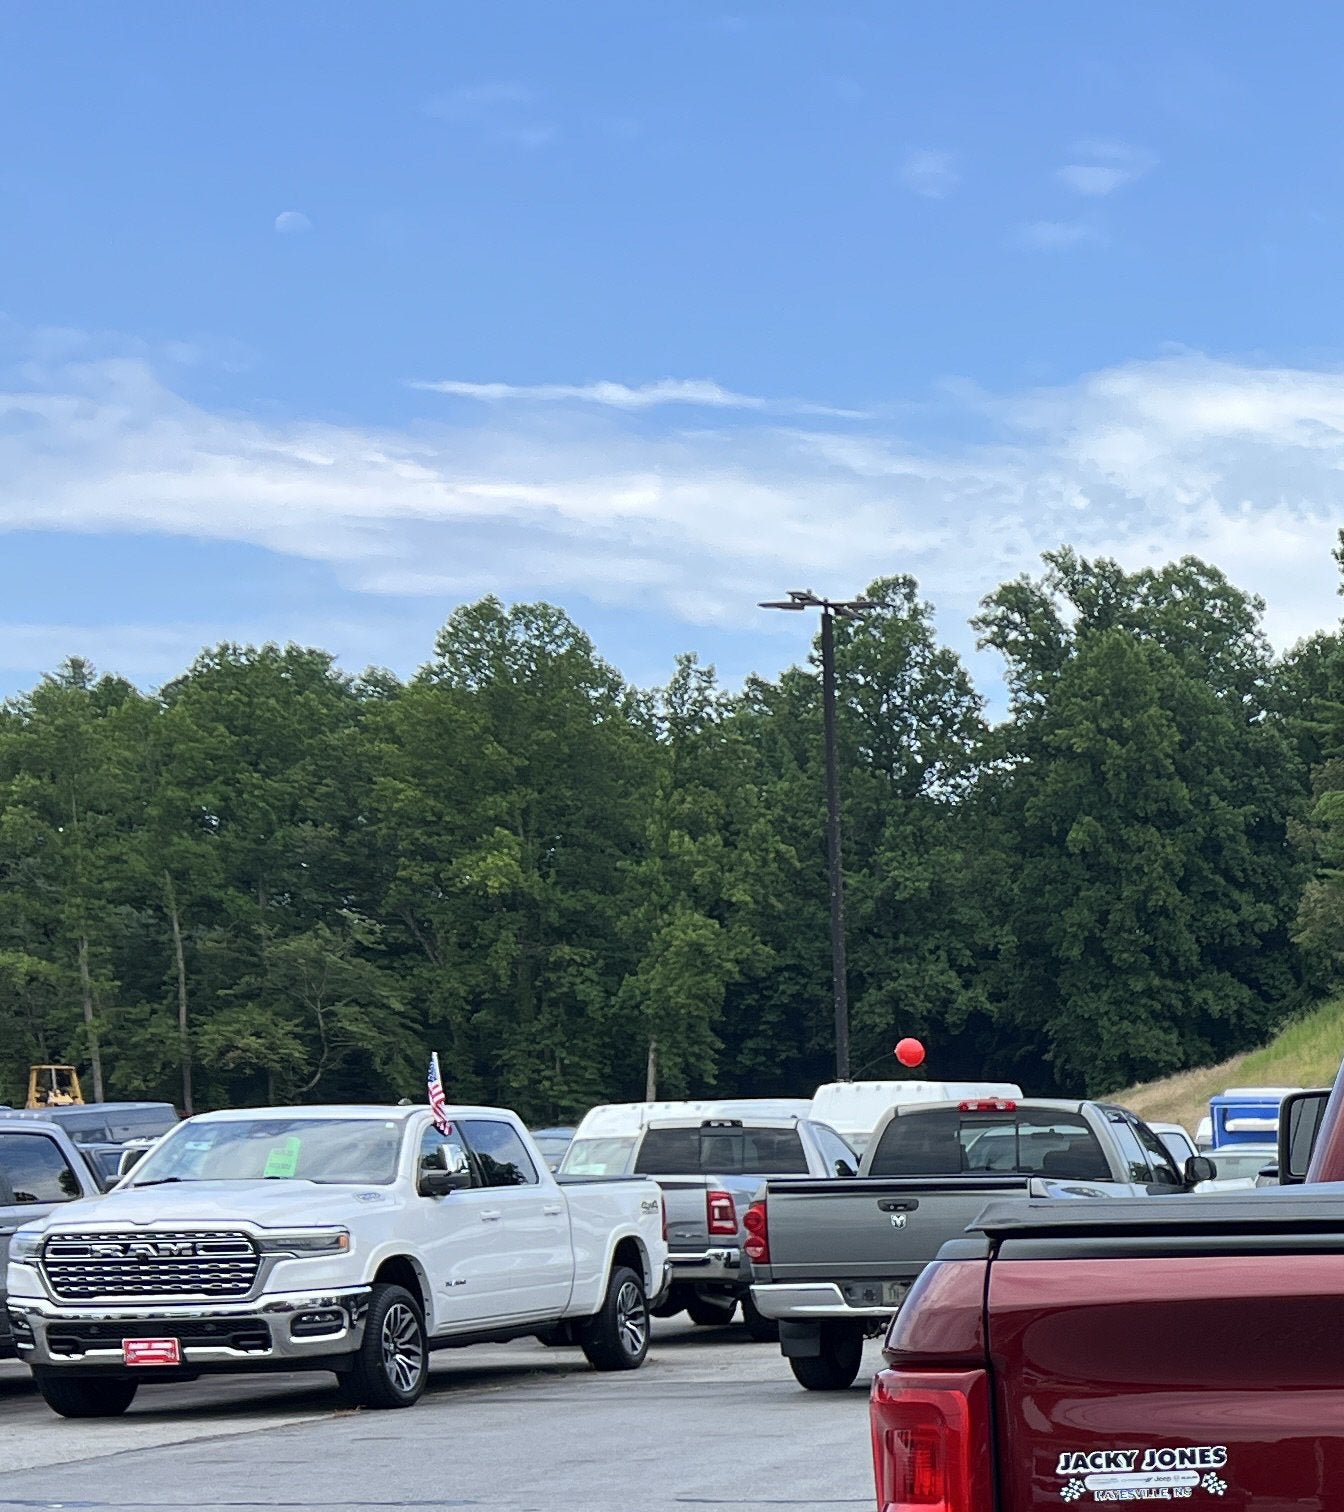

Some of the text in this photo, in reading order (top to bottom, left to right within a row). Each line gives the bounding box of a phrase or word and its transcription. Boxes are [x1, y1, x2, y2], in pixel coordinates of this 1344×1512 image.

[91, 1243, 193, 1258] RAM
[1056, 1446, 1228, 1475] JACKY JONES
